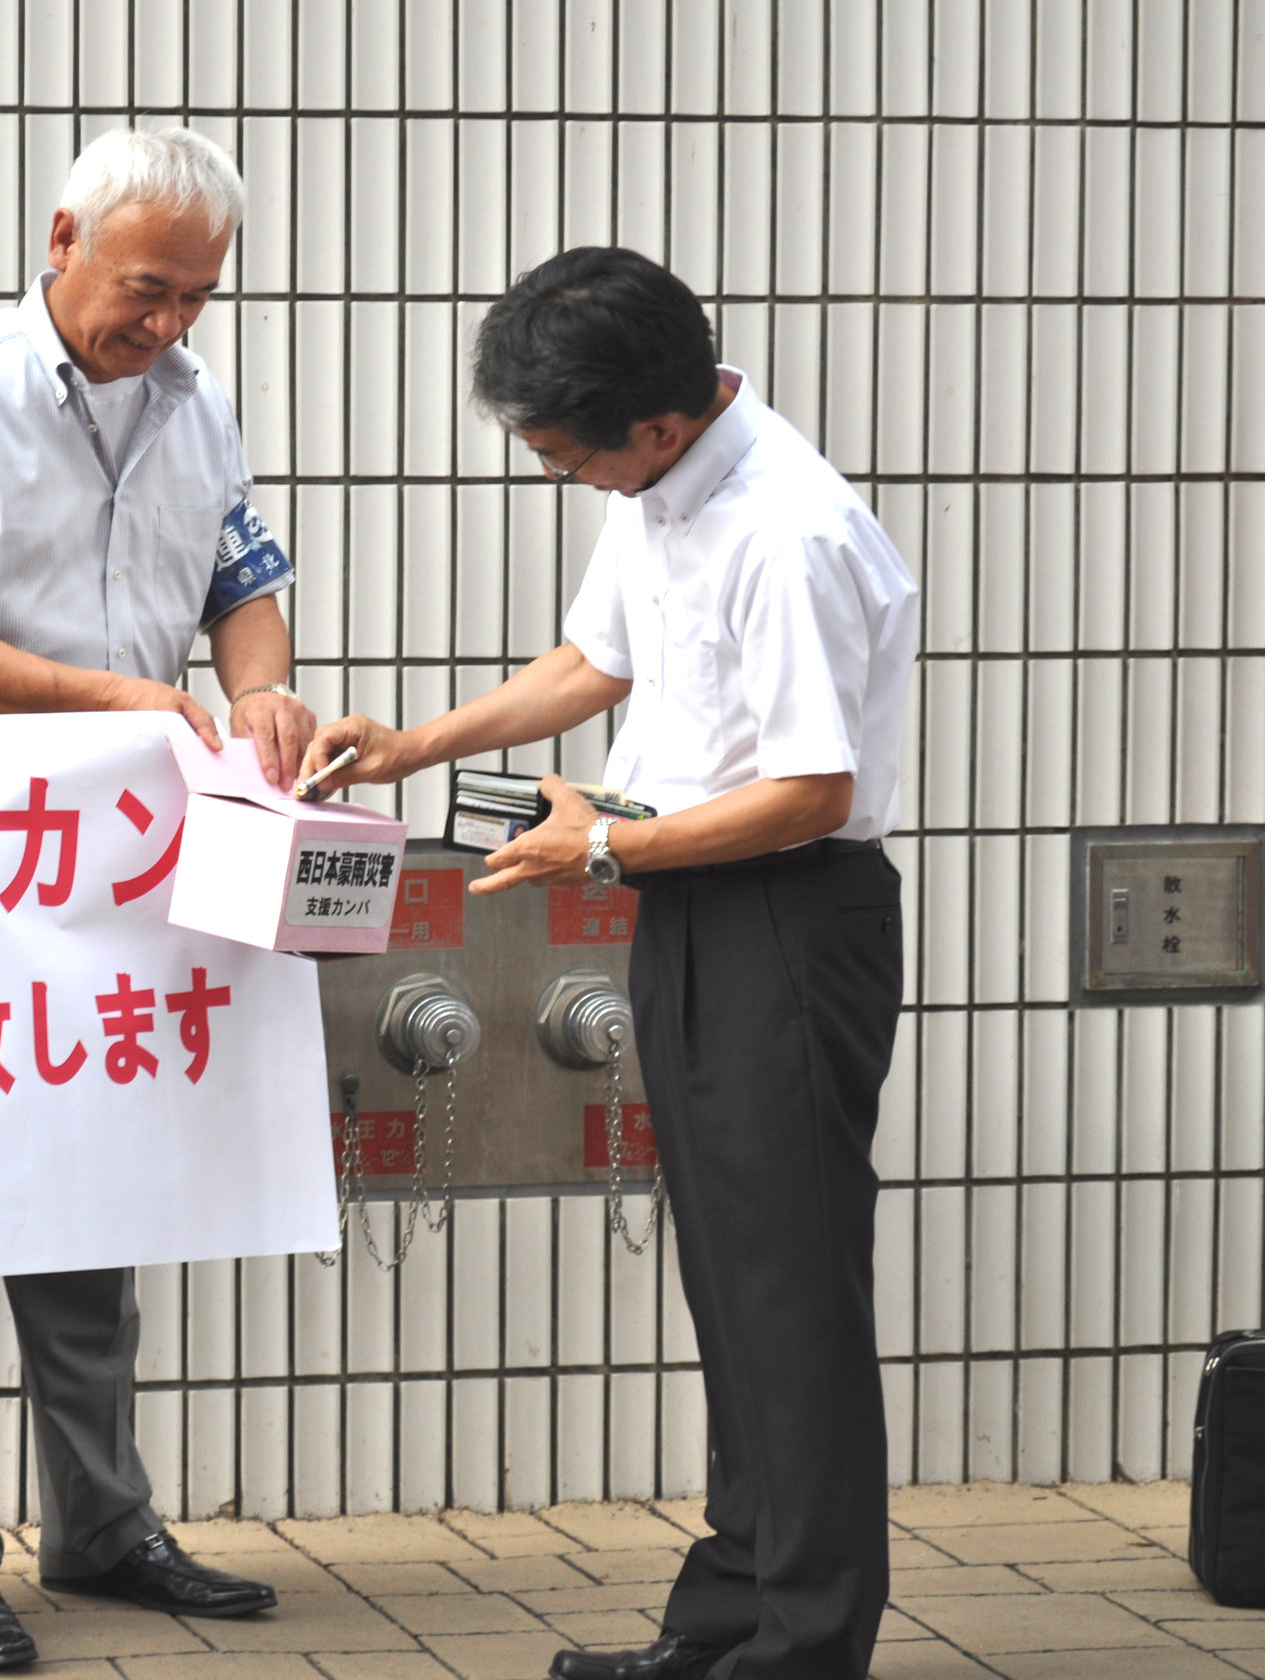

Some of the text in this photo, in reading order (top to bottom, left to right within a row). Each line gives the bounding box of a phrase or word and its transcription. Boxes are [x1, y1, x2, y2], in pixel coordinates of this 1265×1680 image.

[296, 850, 395, 889] 西日本豪雨災害
[1161, 875, 1182, 954] 散水栓
